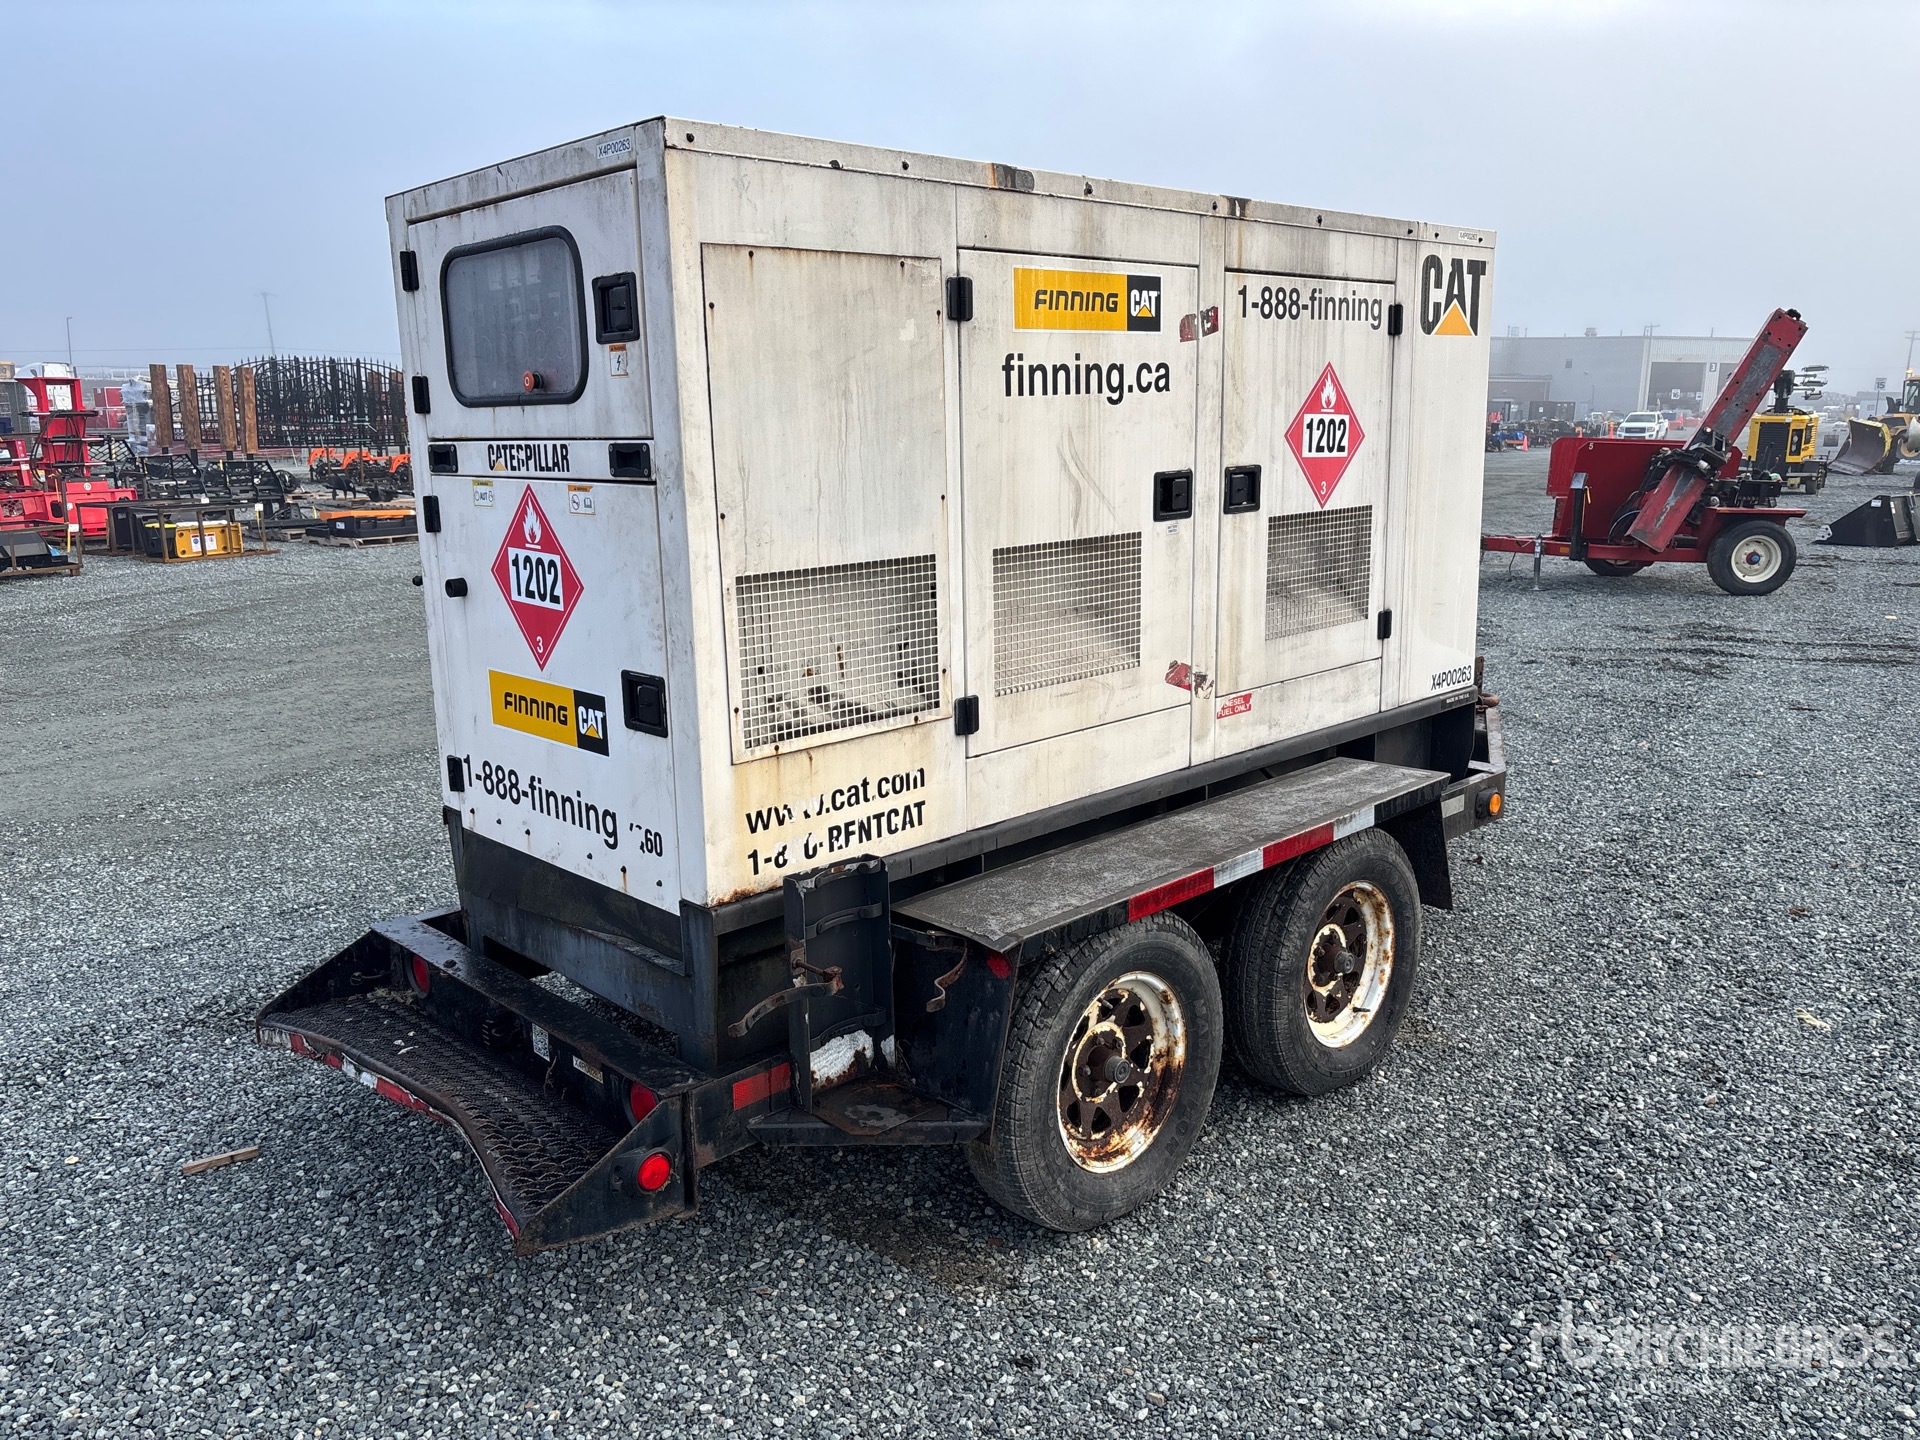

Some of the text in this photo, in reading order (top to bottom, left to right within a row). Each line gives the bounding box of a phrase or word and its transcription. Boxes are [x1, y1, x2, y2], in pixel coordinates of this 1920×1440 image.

[598, 138, 630, 157] X4P00263
[1130, 289, 1158, 318] CAT
[1238, 284, 1383, 331] 1-888-finning
[1420, 254, 1488, 337] CAT
[1002, 352, 1171, 406] finning.ca
[1709, 363, 1716, 371] 3
[1306, 417, 1347, 454] 1202
[487, 443, 571, 473] CATERPILLAR
[1320, 480, 1327, 496] 3
[511, 553, 561, 605] 1202
[536, 635, 544, 654] 3
[1430, 664, 1472, 691] X4P00263
[577, 705, 606, 740] CAT
[1217, 702, 1250, 718] FUEL ONLY
[463, 753, 619, 851] 1-888-finning
